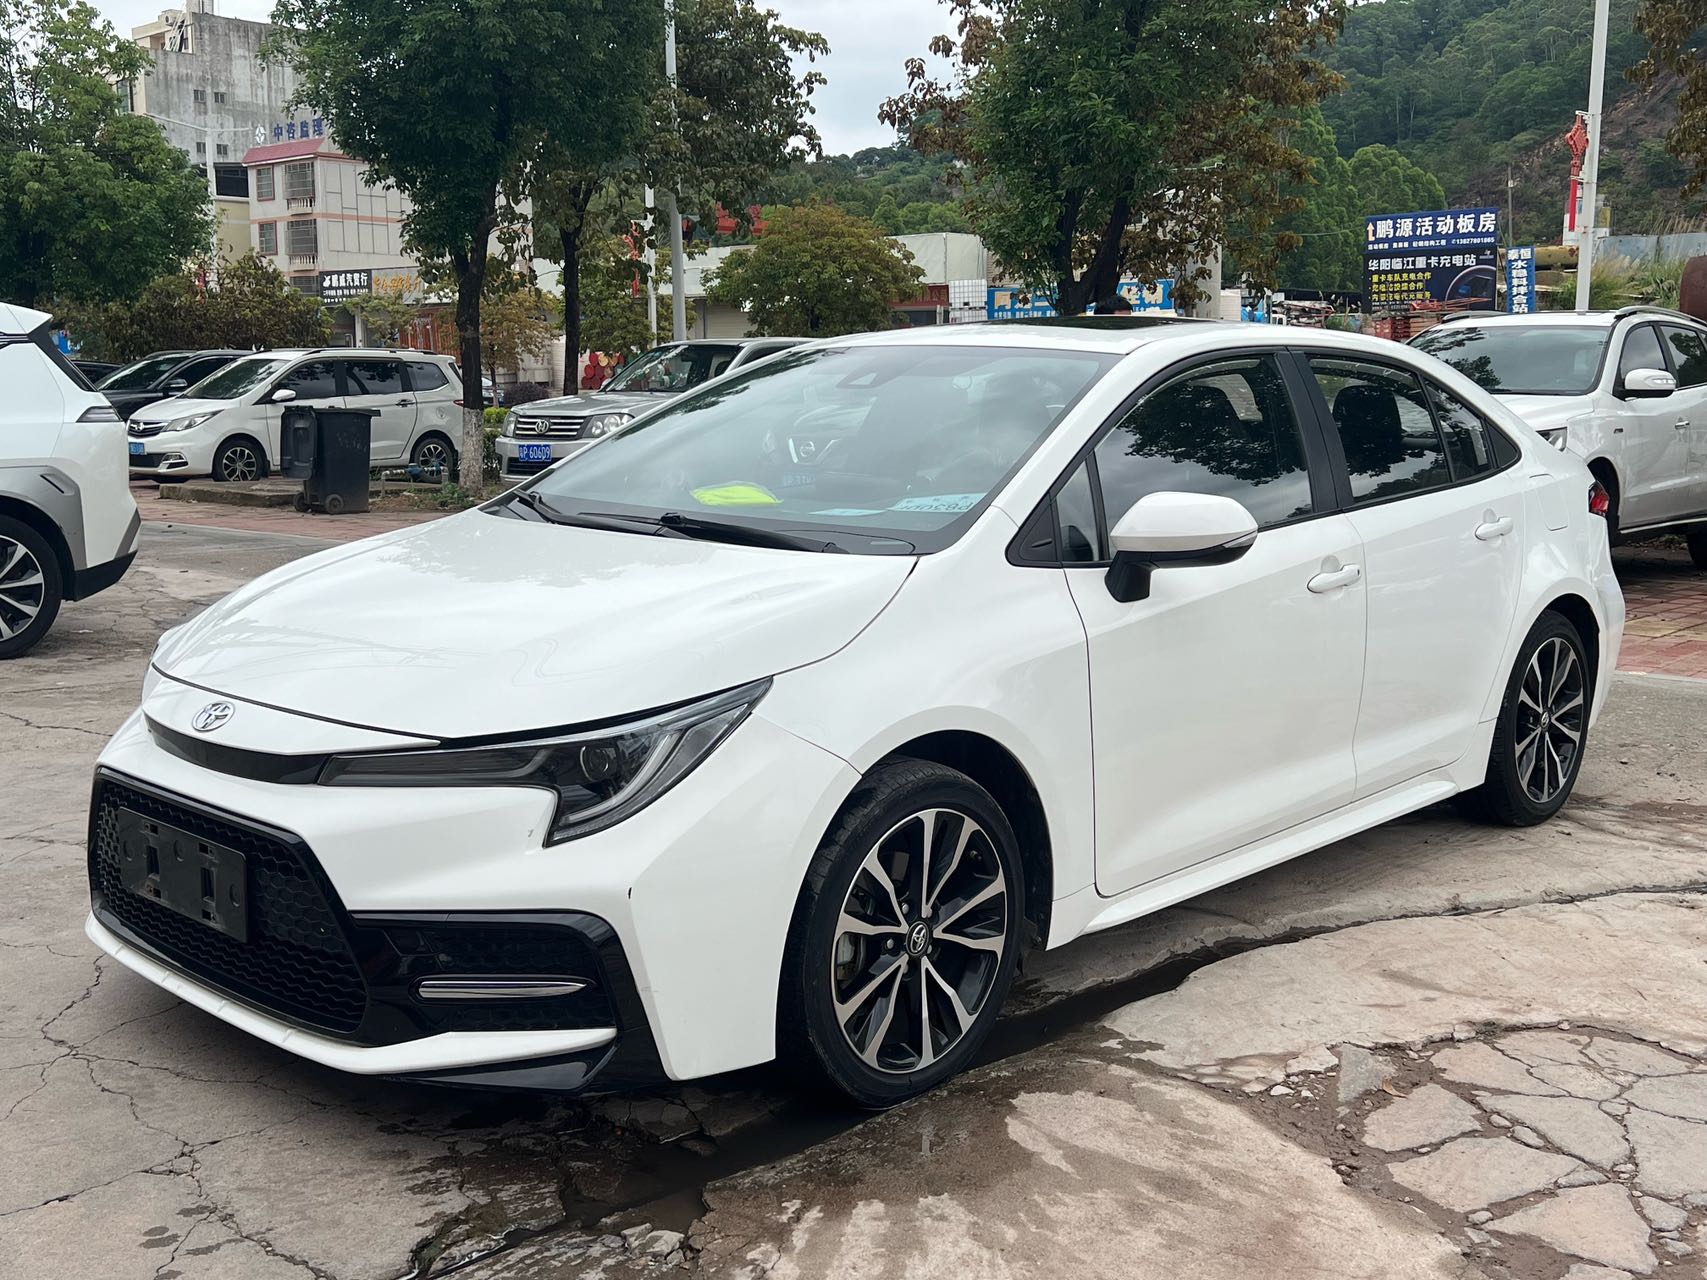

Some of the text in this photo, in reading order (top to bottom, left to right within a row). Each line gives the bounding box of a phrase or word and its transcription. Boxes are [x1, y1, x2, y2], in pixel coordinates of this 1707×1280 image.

[1376, 212, 1496, 239] 鹏源活动板房
[1368, 254, 1477, 271] 华阳临江重卡充电站
